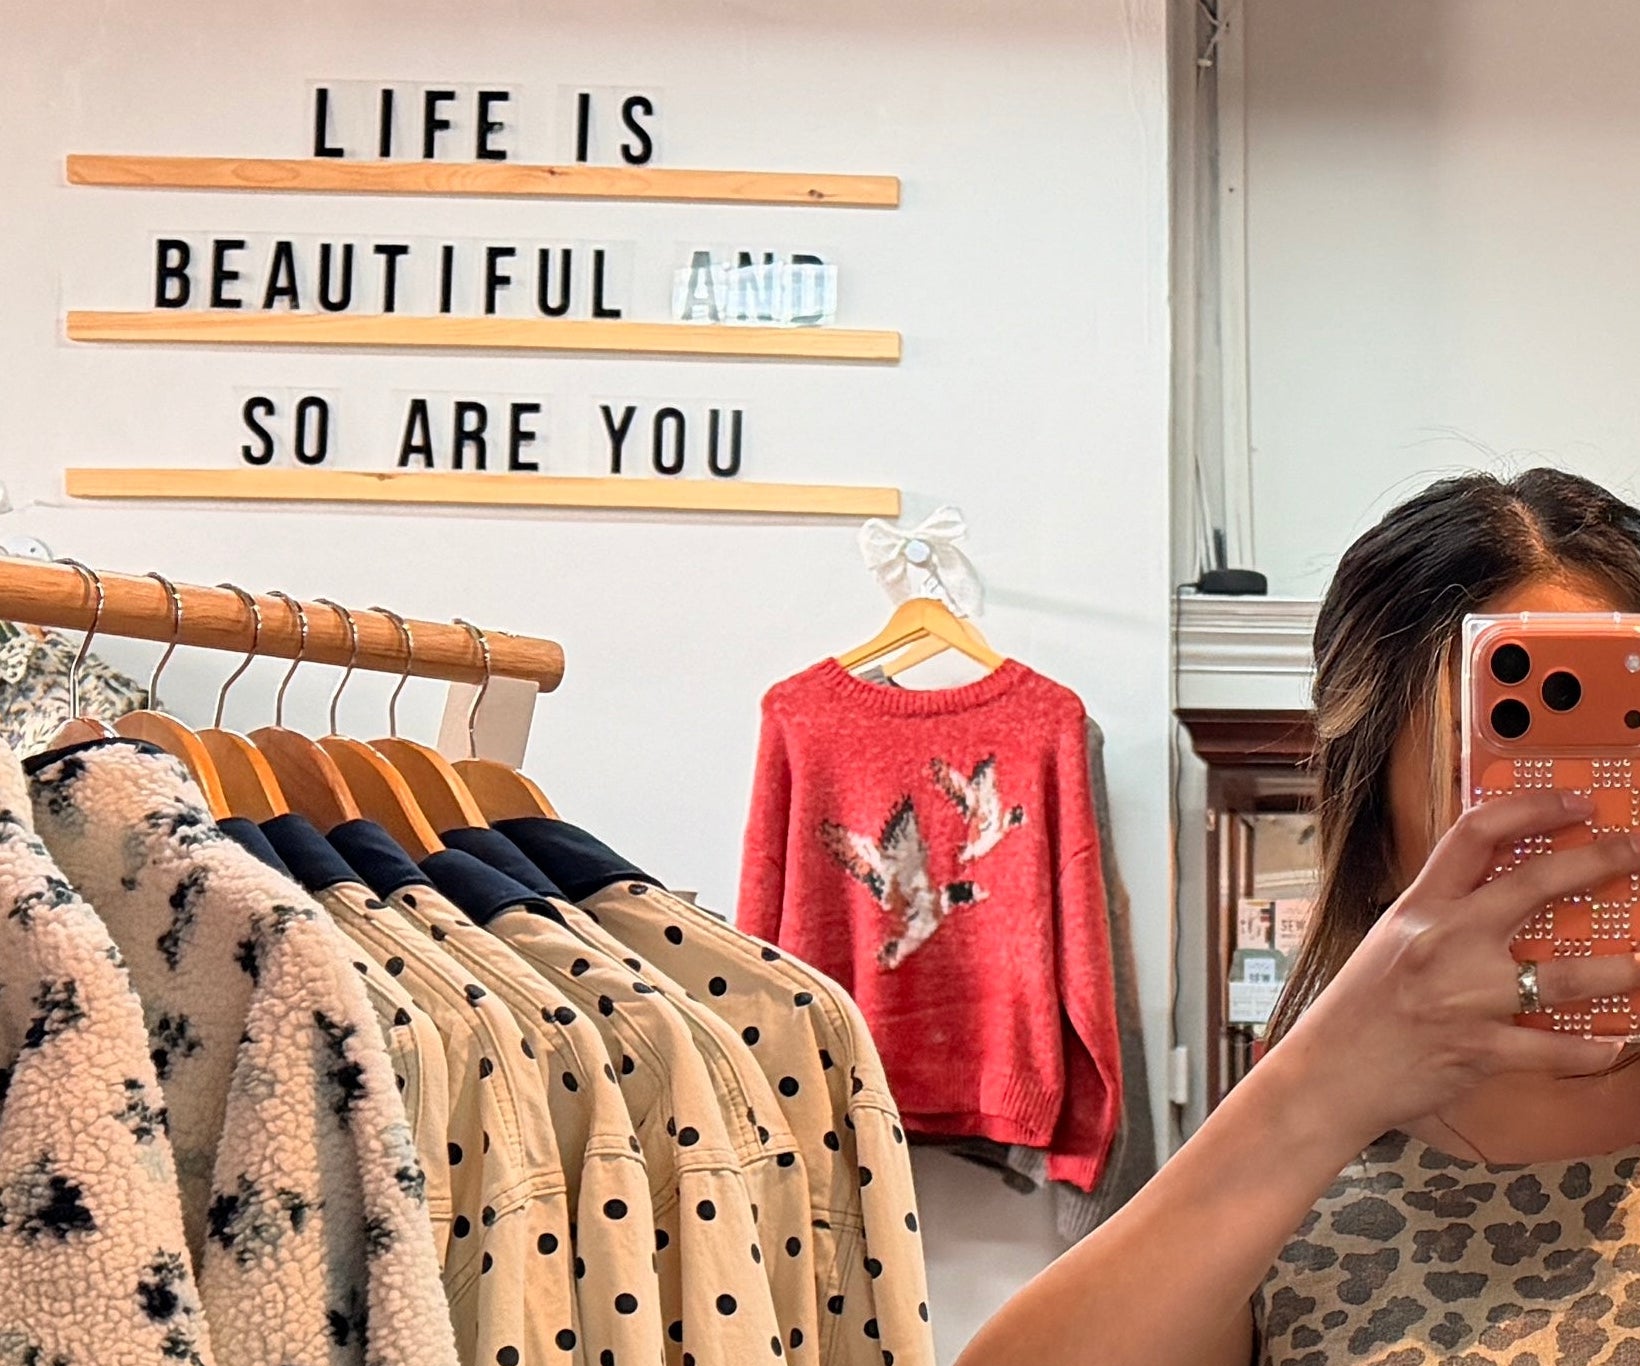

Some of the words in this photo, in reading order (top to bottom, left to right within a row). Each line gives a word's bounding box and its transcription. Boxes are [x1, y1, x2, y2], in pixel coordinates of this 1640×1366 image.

[314, 88, 510, 160] LIFE
[576, 93, 653, 166] IS
[155, 238, 621, 319] BEAUTIFUL
[242, 396, 329, 466] SO
[398, 398, 541, 472] ARE
[600, 405, 742, 478] YOU
